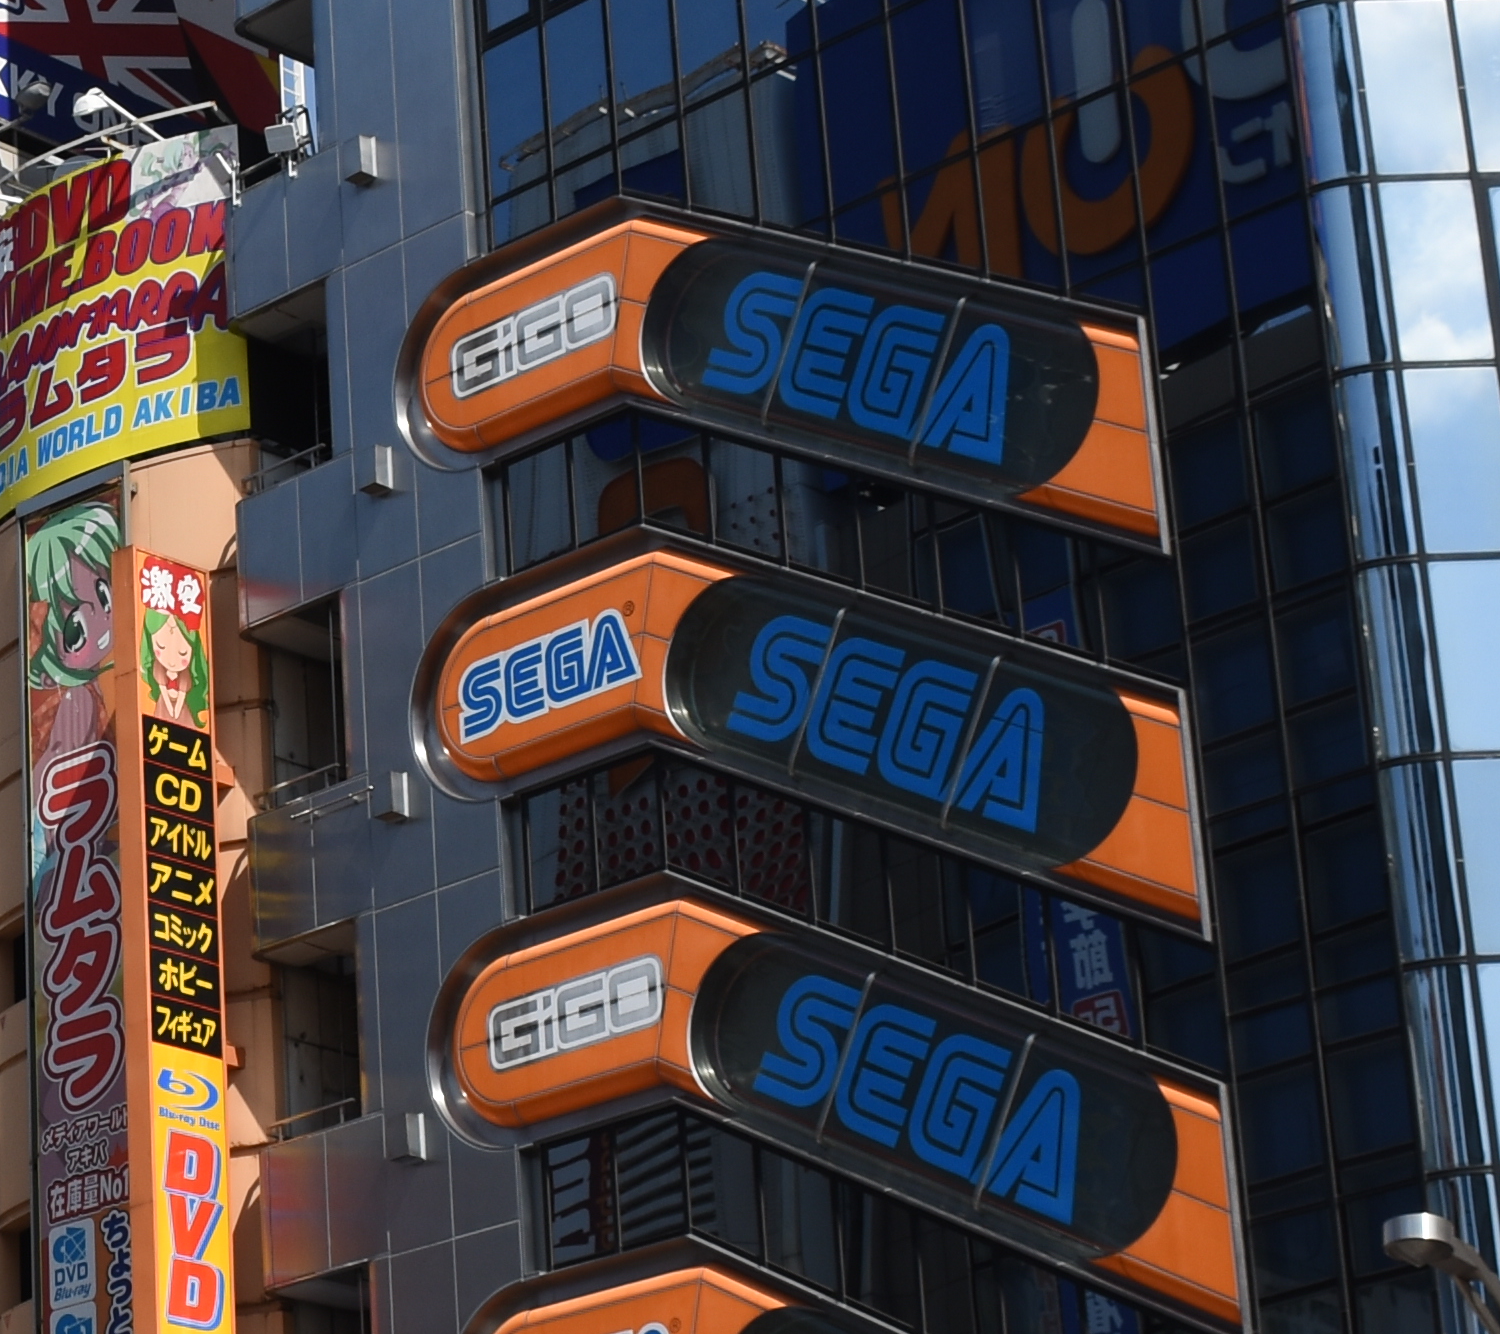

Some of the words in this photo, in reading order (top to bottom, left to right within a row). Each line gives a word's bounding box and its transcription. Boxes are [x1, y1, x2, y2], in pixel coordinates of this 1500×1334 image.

[15, 158, 132, 266] DVD
[700, 269, 1012, 466] SEGA
[37, 405, 123, 467] WORLD
[132, 375, 242, 429] AKIBA
[140, 563, 203, 617] 激安
[457, 607, 643, 745] SEGA
[148, 721, 207, 771] ゲーム
[727, 614, 1046, 835] SEGA
[155, 771, 202, 813] CD
[150, 816, 212, 862] アイドル
[150, 863, 214, 907] アニメ
[41, 744, 123, 1106] ラムタラ
[153, 912, 214, 954] コミック
[157, 957, 214, 996] ホビー
[155, 1003, 217, 1046] フィギュア
[158, 1105, 197, 1124] Blu-ray
[752, 974, 1082, 1226] SEGA
[66, 1139, 109, 1174] アキバ
[163, 1129, 225, 1331] DVD
[55, 1261, 89, 1286] DVD
[55, 1281, 92, 1301] Blu-ray
